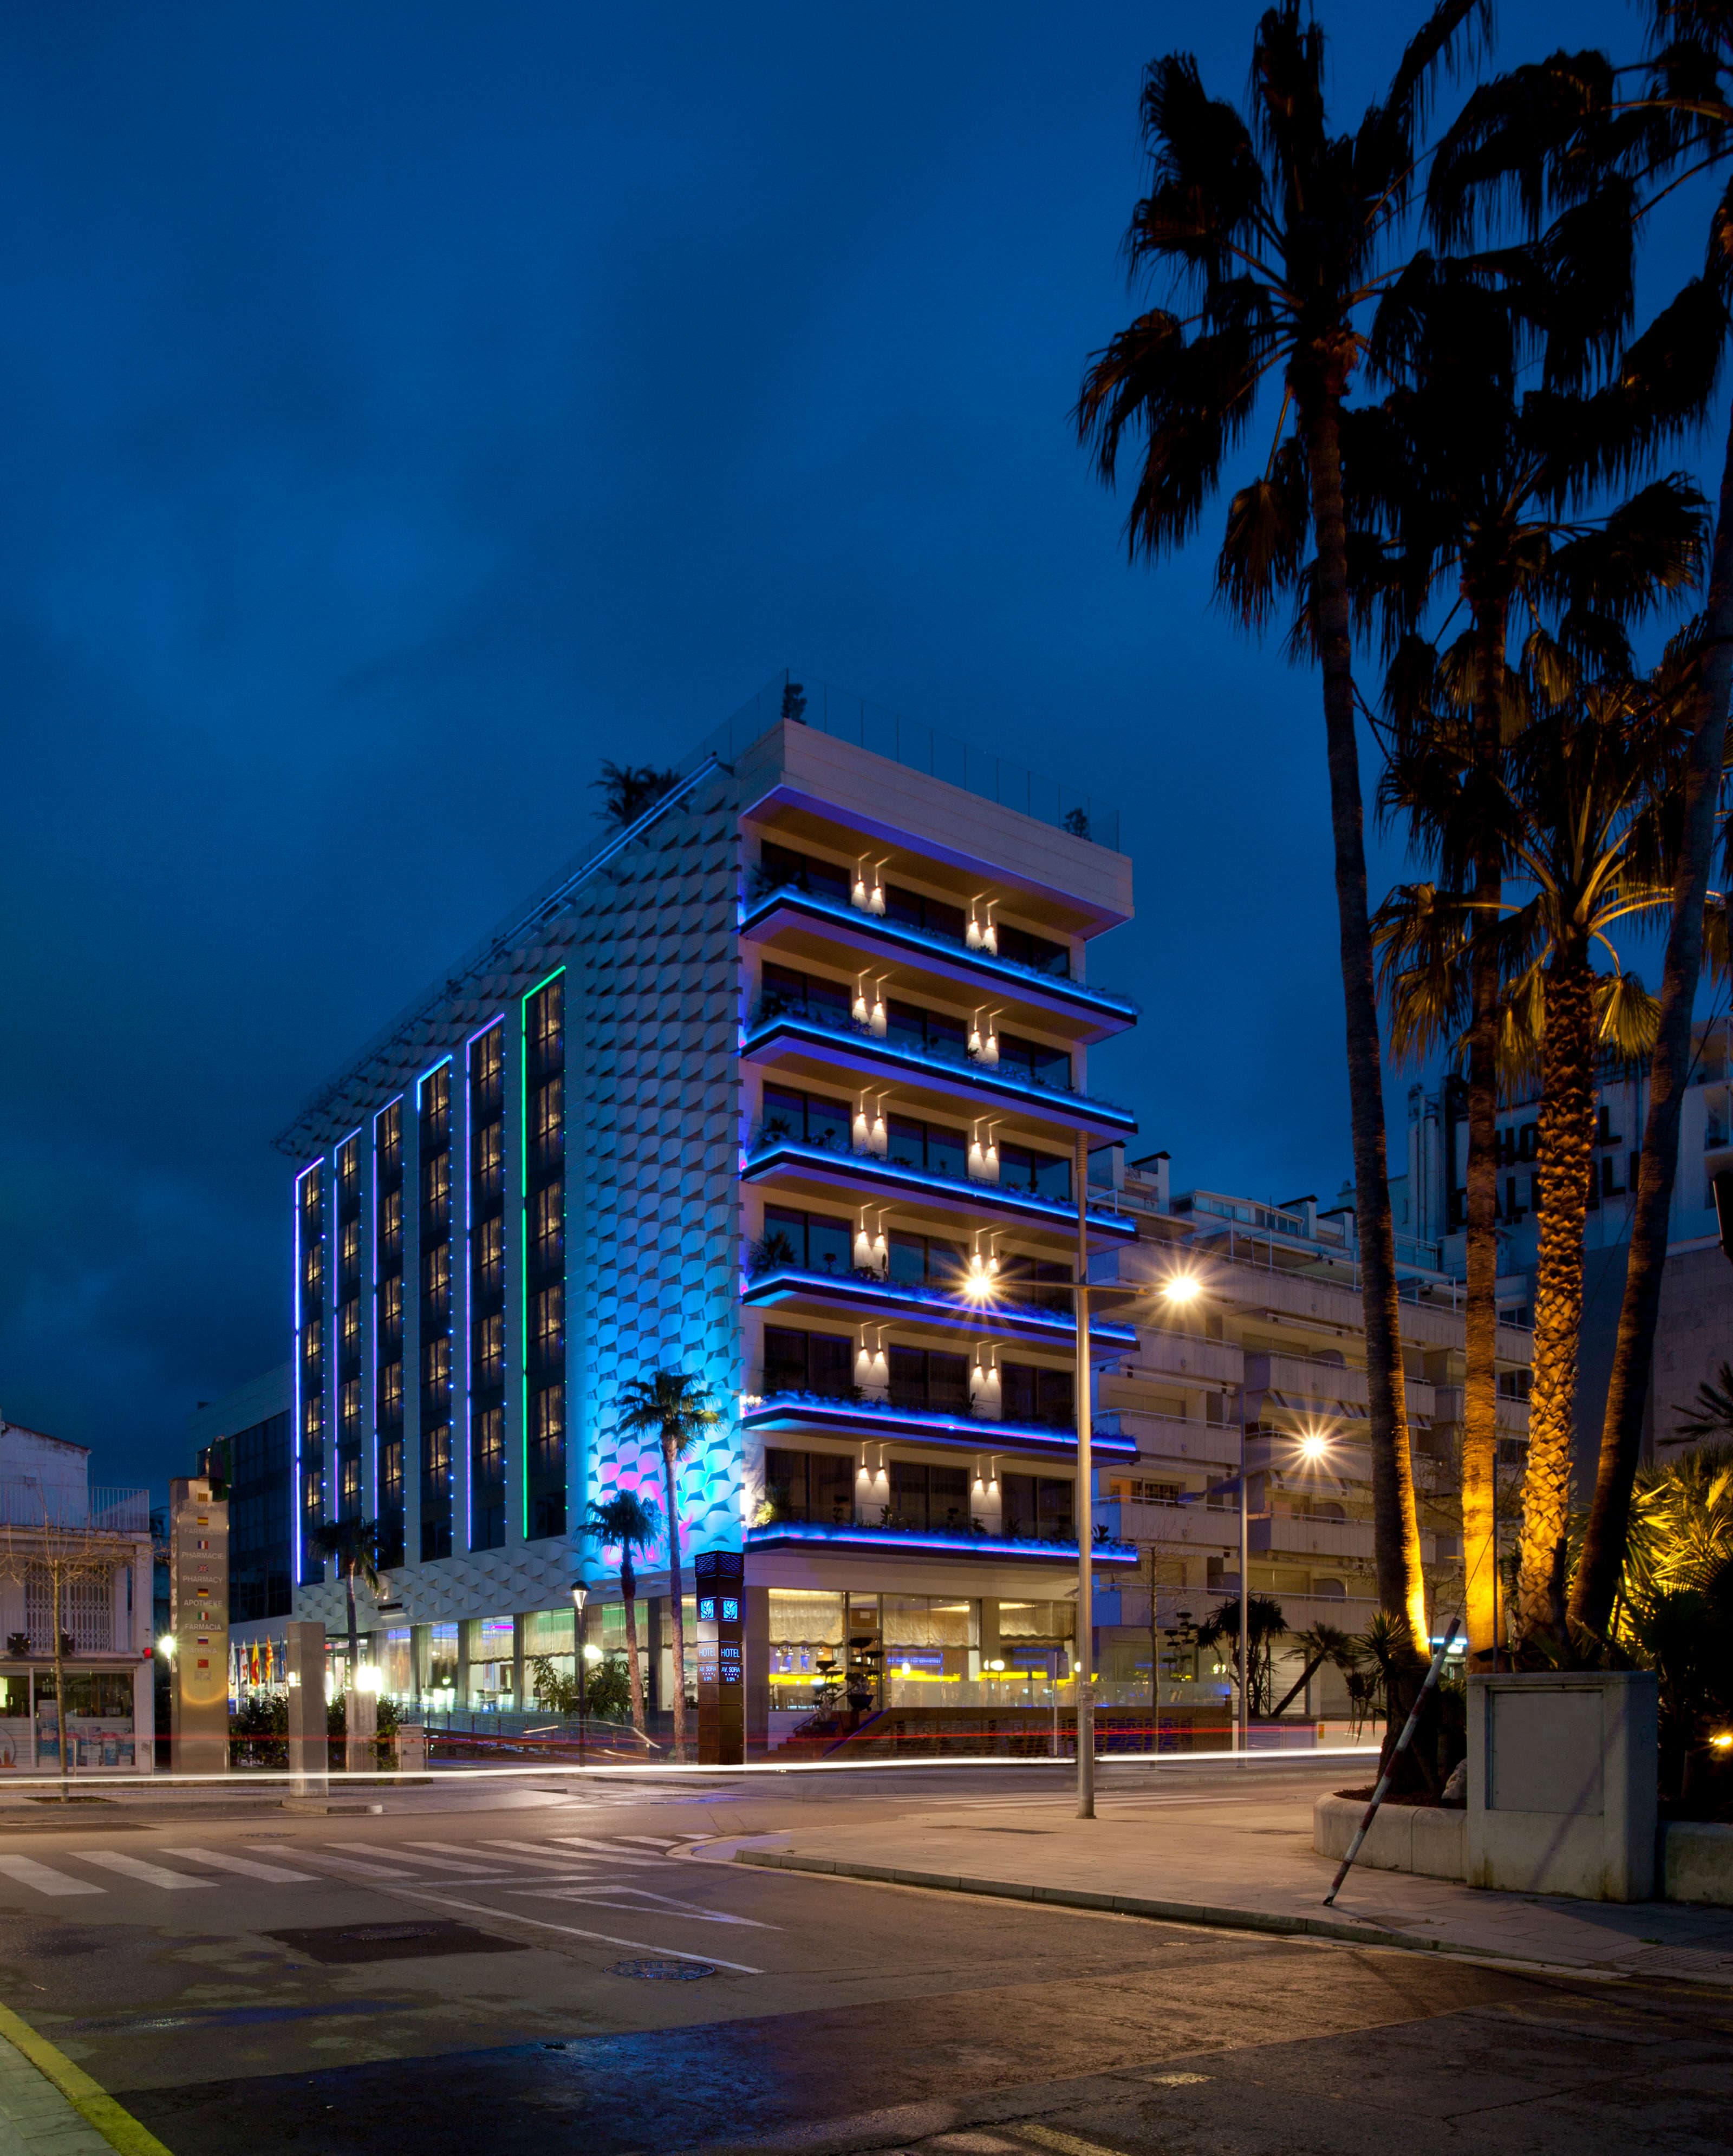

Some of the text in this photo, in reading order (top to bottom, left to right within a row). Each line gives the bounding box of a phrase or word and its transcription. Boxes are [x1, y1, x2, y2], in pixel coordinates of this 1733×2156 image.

[1495, 1106, 1621, 1168] HOL
[181, 1552, 224, 1560] PHARMACIE
[183, 1575, 223, 1583] PHARMACY
[699, 1648, 716, 1657] HOTEL
[721, 1648, 740, 1658] HOTEL
